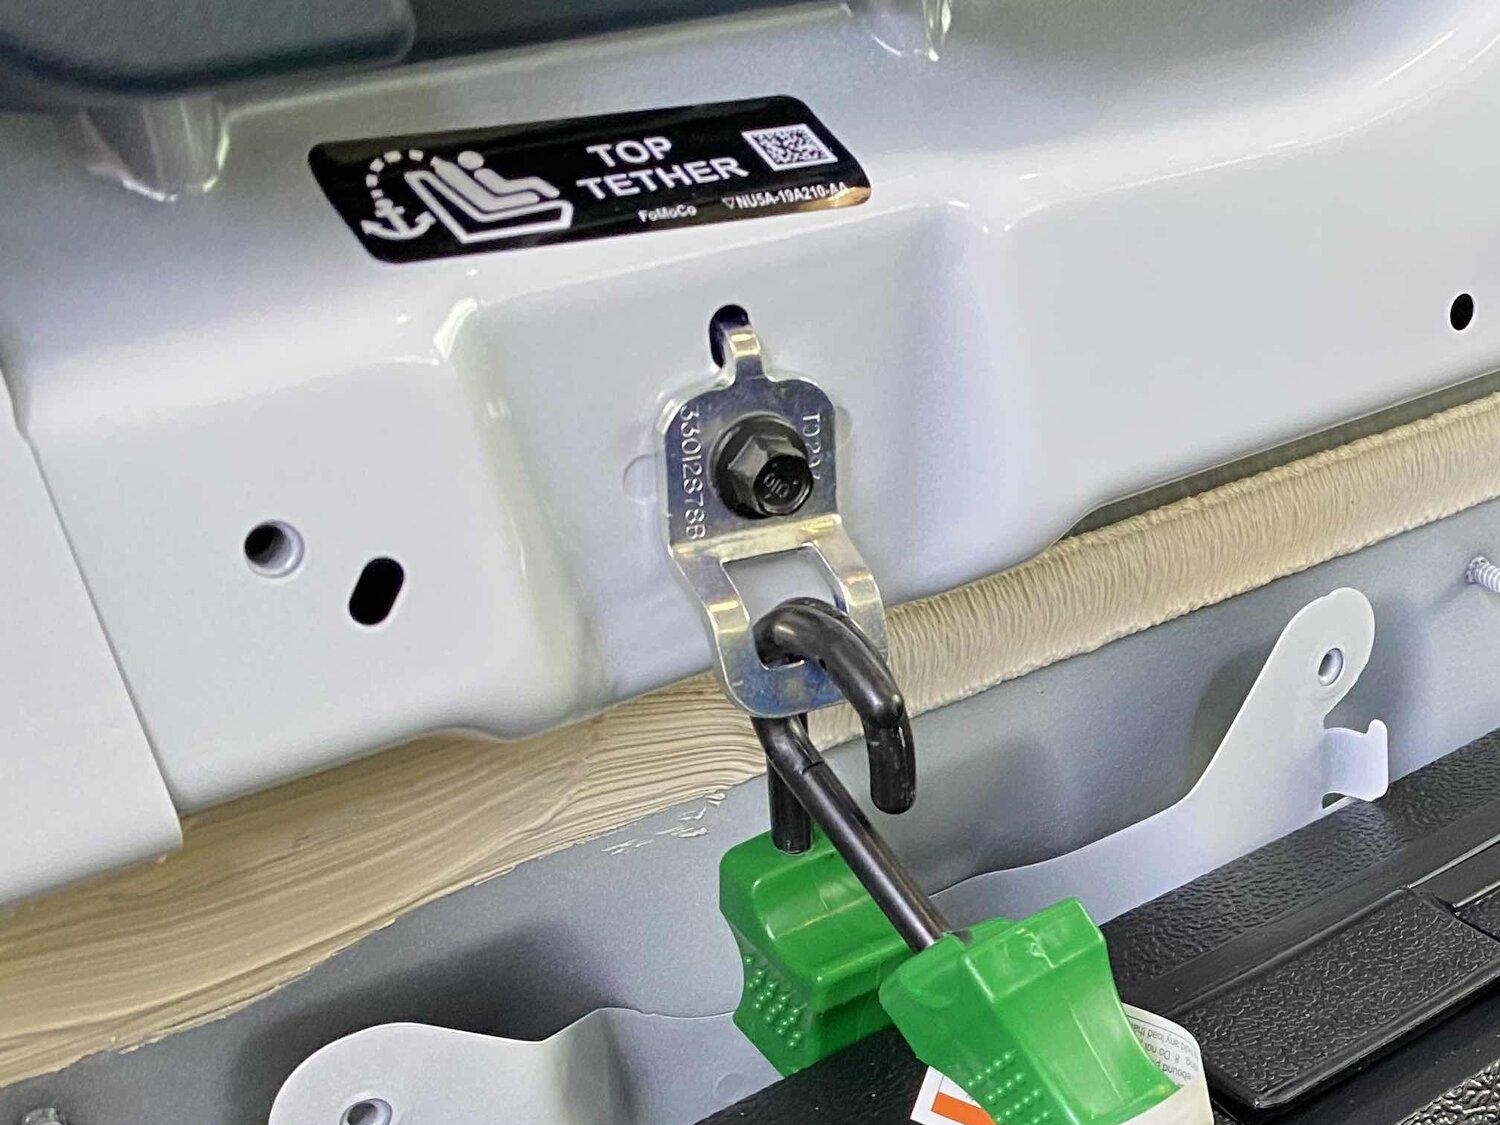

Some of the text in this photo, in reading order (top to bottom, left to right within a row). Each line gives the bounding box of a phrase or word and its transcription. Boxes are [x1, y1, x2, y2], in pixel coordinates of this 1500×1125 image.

[586, 136, 672, 168] TOP
[576, 157, 750, 200] TETHER
[638, 204, 697, 223] FoMoCo
